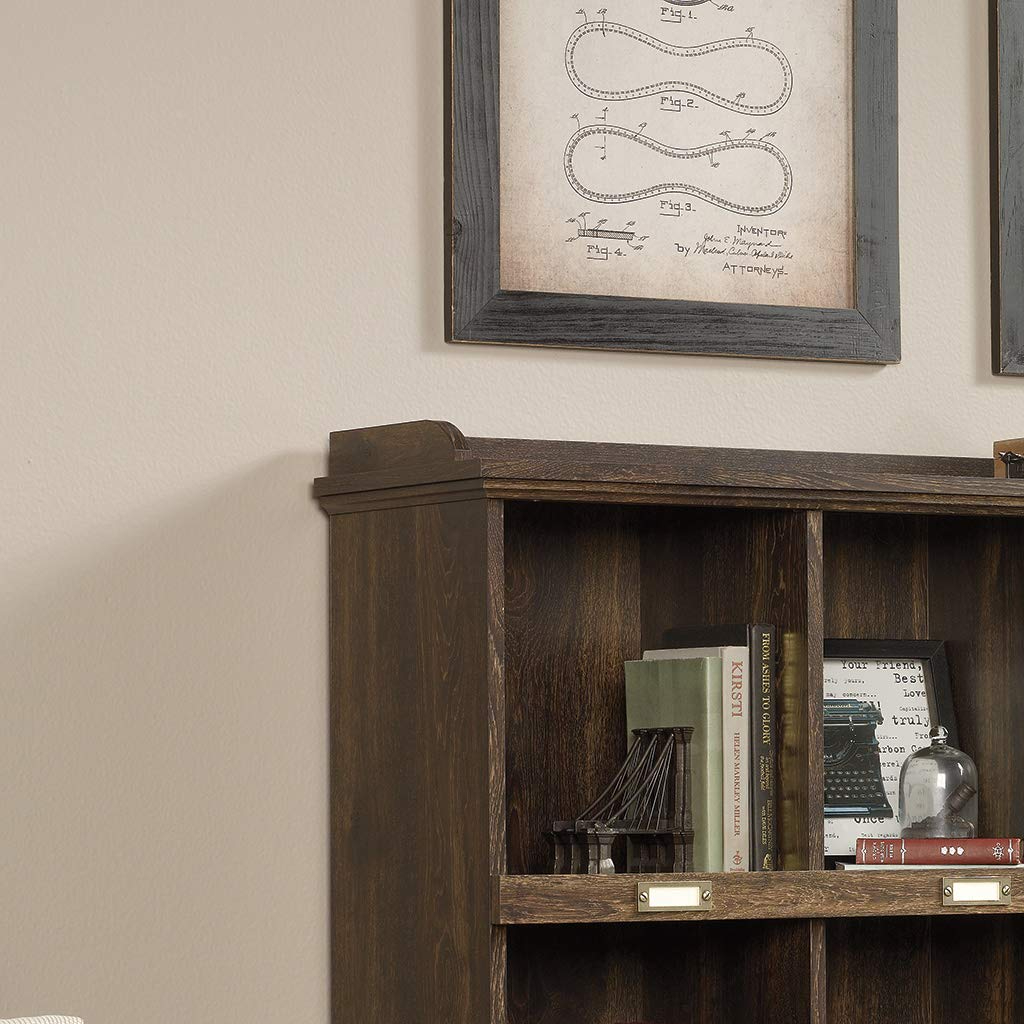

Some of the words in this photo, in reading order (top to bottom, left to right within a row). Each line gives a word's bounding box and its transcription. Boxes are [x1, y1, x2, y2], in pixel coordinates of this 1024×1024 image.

[762, 633, 771, 660] FROM
[841, 660, 868, 670] Your
[762, 663, 771, 693] ASHES
[893, 673, 924, 684] Best
[731, 661, 743, 718] KIRSTI
[903, 689, 927, 698] Love
[762, 697, 771, 710] TO
[892, 715, 930, 727] truly
[762, 712, 771, 745] GLORY
